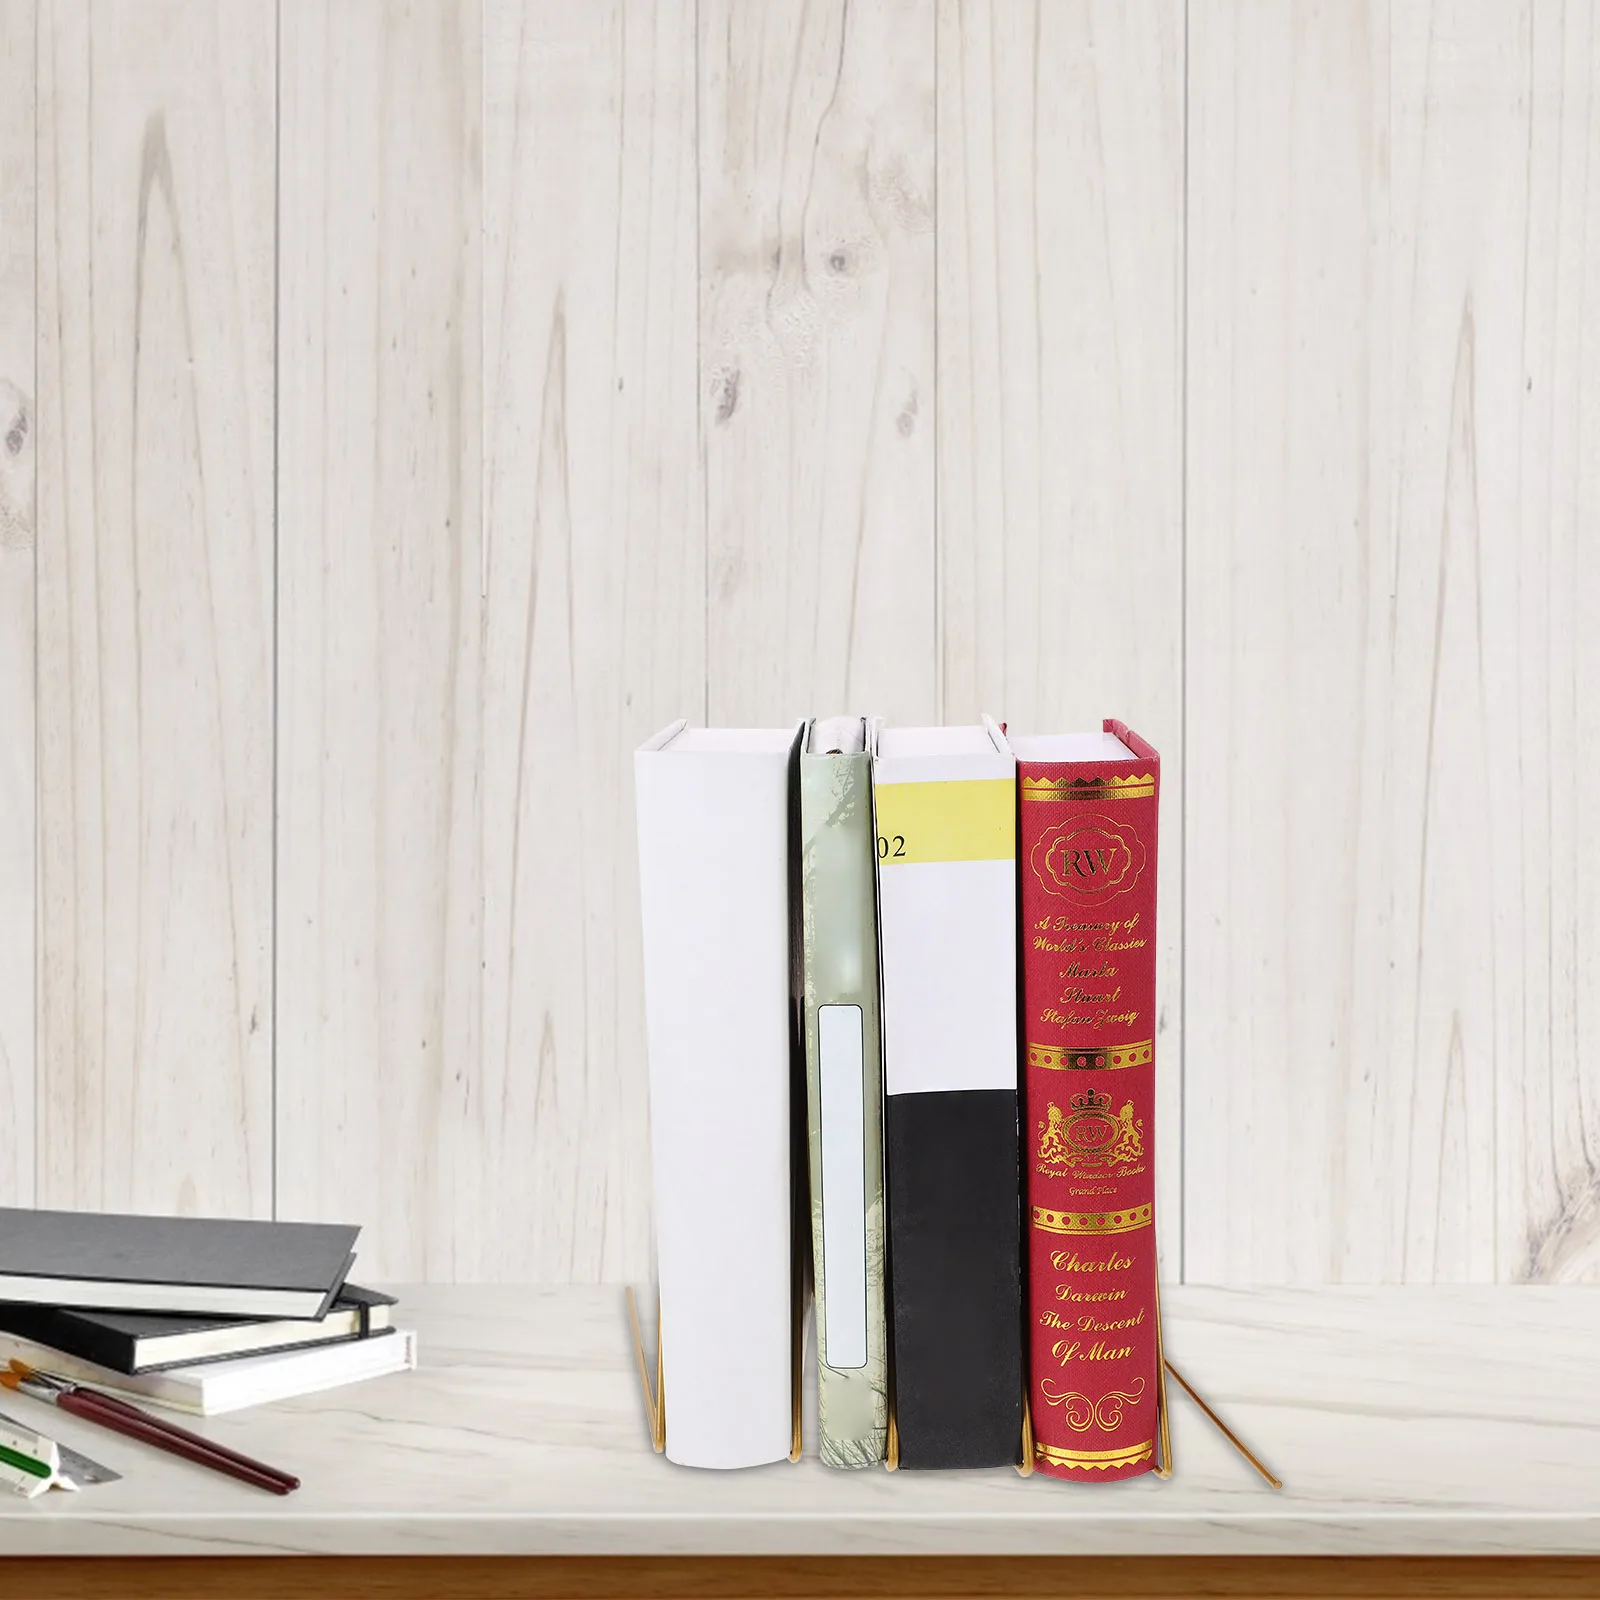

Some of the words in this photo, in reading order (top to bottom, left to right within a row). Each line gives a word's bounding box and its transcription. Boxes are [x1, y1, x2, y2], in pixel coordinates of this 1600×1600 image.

[877, 835, 906, 858] 02
[1061, 848, 1117, 877] RW
[1034, 916, 1050, 931] A
[1123, 912, 1140, 934] of
[1033, 936, 1089, 953] World's
[1093, 937, 1147, 952] Classics
[1060, 986, 1121, 1004] Stuart
[1074, 1125, 1109, 1142] RW
[1036, 1163, 1068, 1179] Royal
[1072, 1169, 1114, 1180] Windsor
[1116, 1164, 1146, 1178] Books
[1069, 1186, 1096, 1196] Grand
[1097, 1185, 1118, 1195] Place
[1050, 1250, 1136, 1273] Charles
[1055, 1283, 1128, 1302] Darwin
[1039, 1310, 1074, 1330] The
[1077, 1307, 1145, 1332] Descent
[1051, 1340, 1081, 1367] Of
[1079, 1340, 1136, 1361] Man
